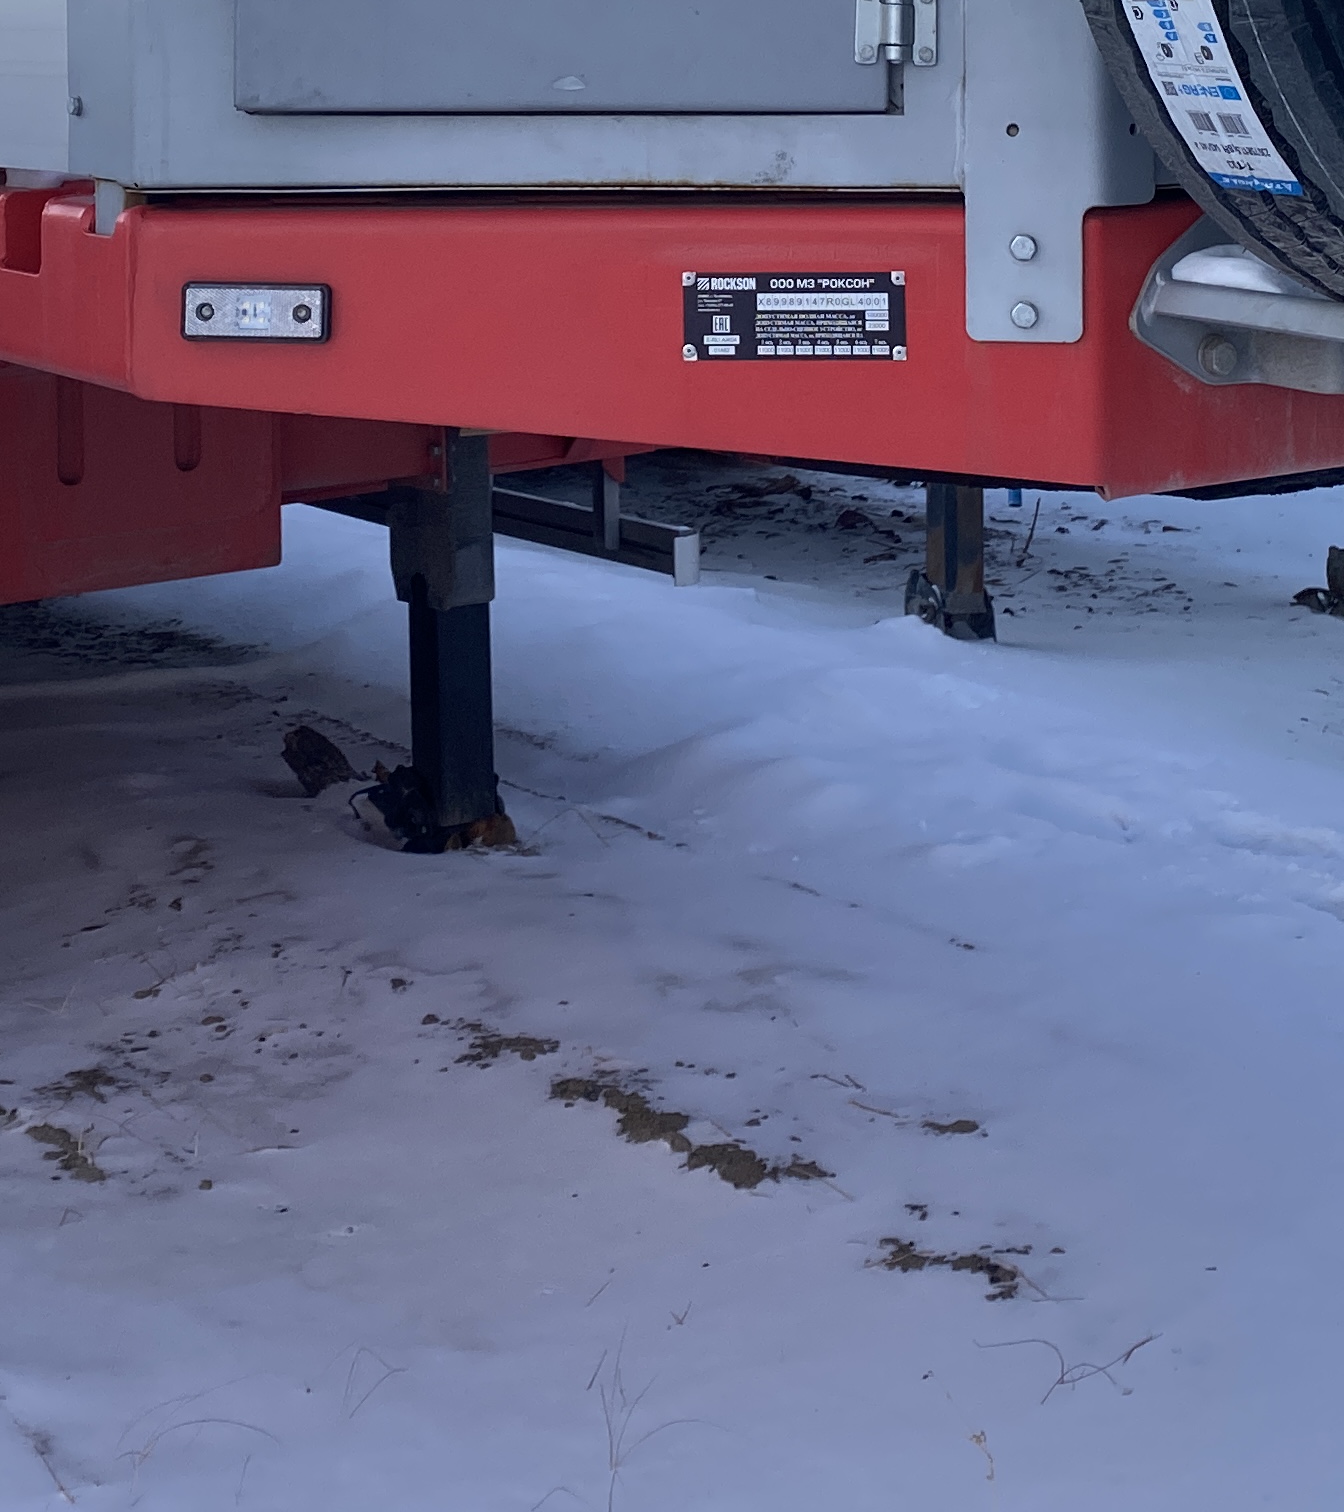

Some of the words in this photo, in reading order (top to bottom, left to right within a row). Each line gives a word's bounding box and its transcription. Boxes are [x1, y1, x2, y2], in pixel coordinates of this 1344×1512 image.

[711, 278, 756, 290] ROCKSON
[770, 278, 794, 289] ООО
[796, 279, 815, 289] МЗ
[817, 278, 875, 289] "РОКСОН"
